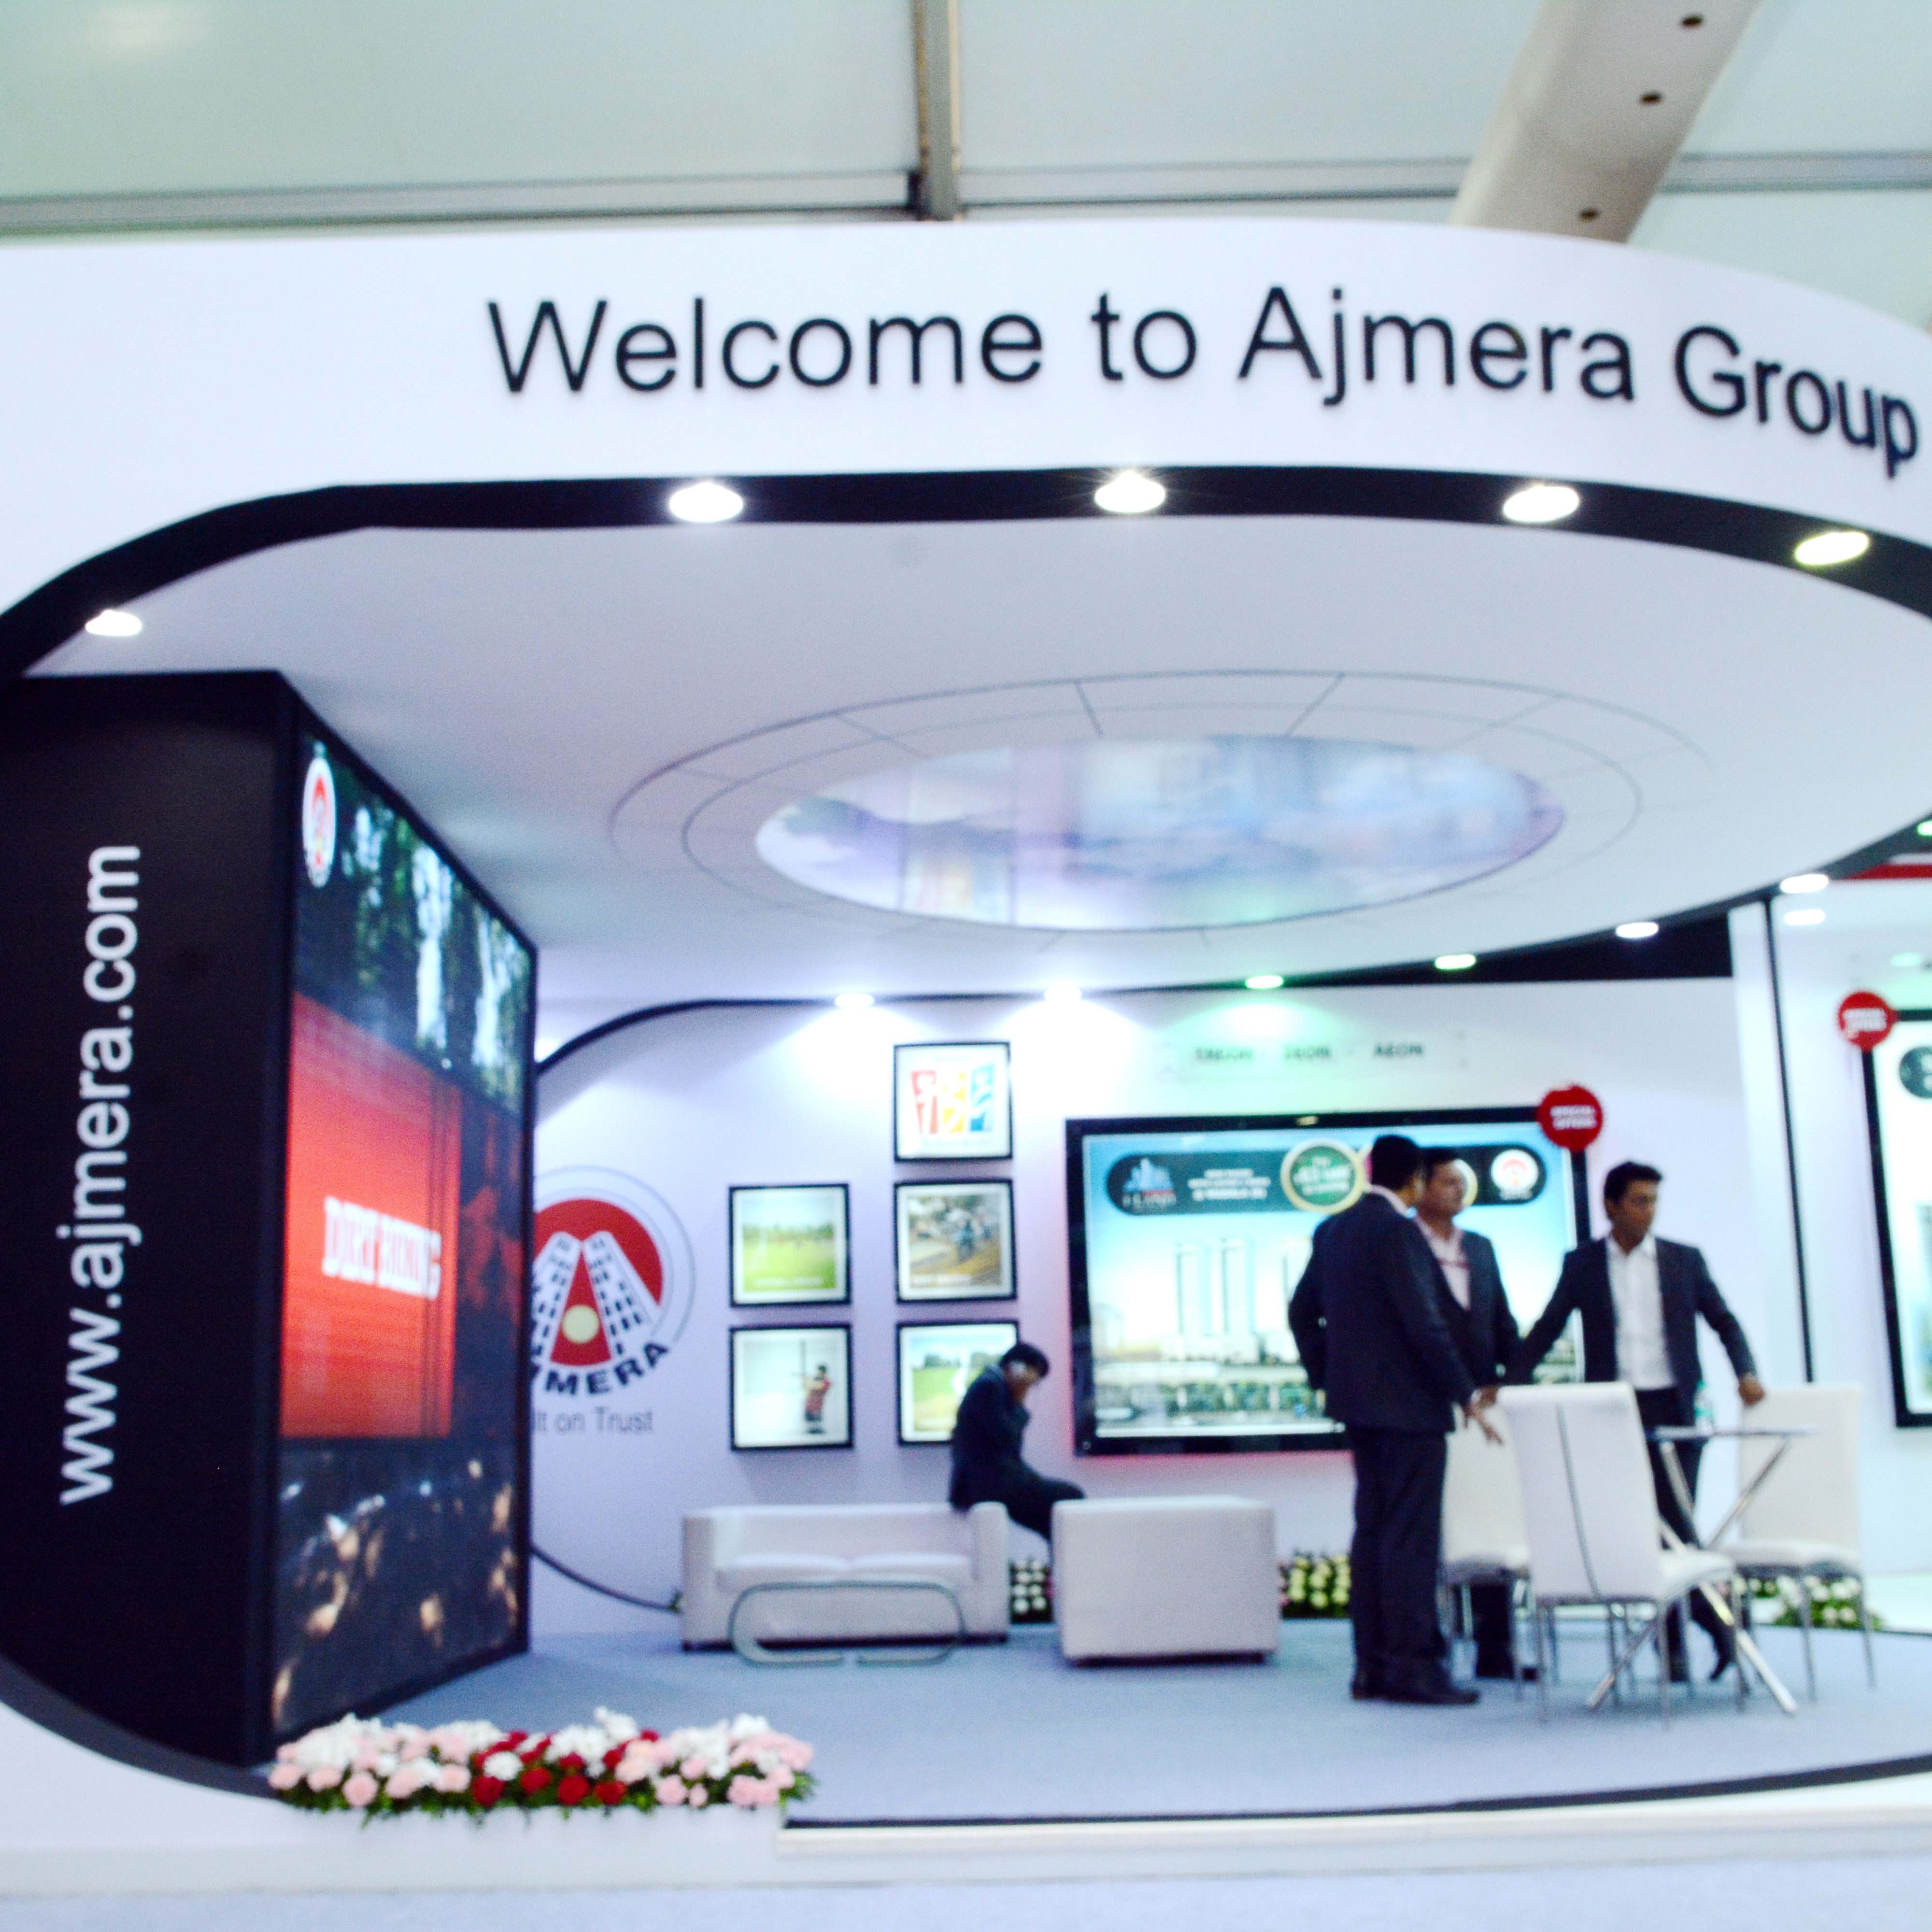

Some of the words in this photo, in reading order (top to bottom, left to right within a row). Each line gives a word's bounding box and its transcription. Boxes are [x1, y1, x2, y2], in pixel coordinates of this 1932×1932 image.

[487, 296, 1043, 394] Welcome
[1090, 293, 1198, 383] to
[1237, 285, 1635, 408] Ajmera
[1673, 324, 1919, 480] Group
[56, 844, 142, 1505] www.ajmera.com
[532, 1341, 669, 1396] MERA
[554, 1411, 586, 1435] on
[595, 1405, 654, 1435] Trust
